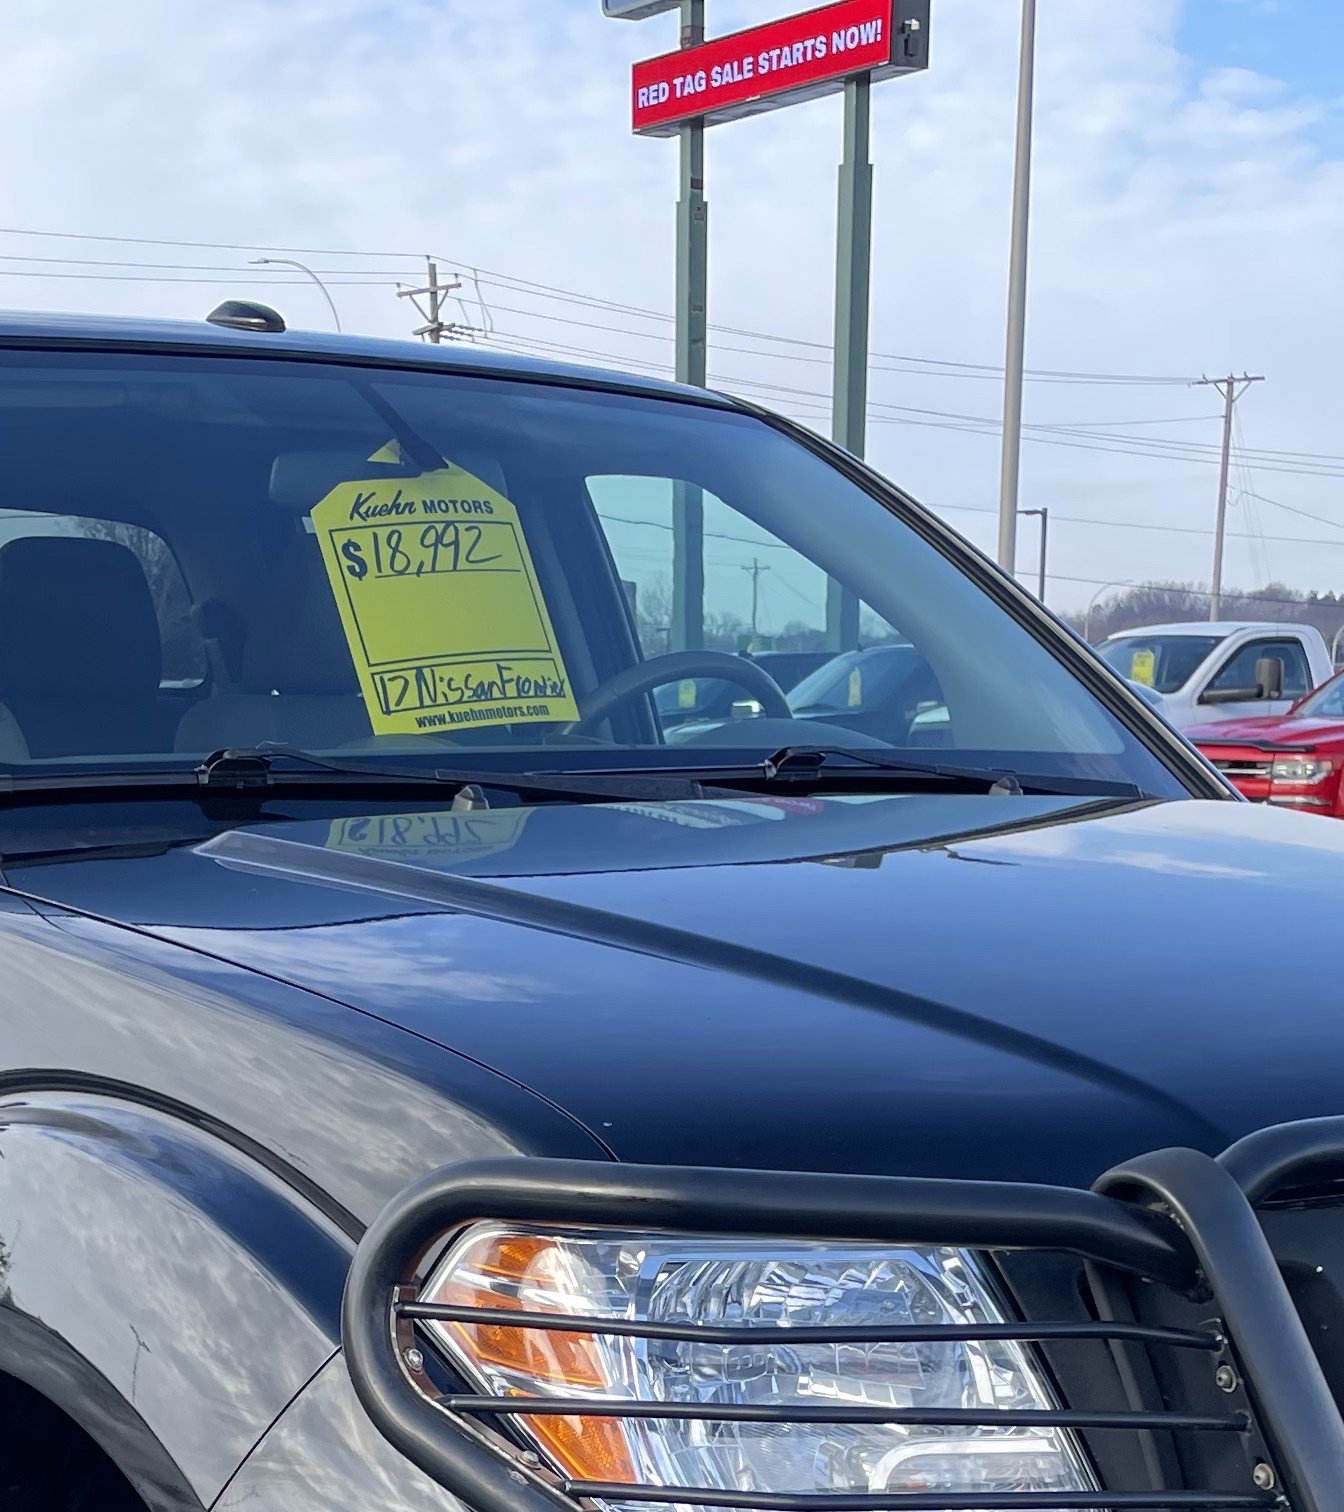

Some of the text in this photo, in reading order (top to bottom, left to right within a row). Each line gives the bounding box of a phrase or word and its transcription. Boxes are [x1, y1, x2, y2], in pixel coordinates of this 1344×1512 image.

[638, 18, 883, 109] RED TAG SALE STARTS NOW!
[349, 489, 494, 522] Kuehn MOTORS
[415, 665, 504, 709] Nissan
[416, 704, 550, 729] www.kuehnmotors.com
